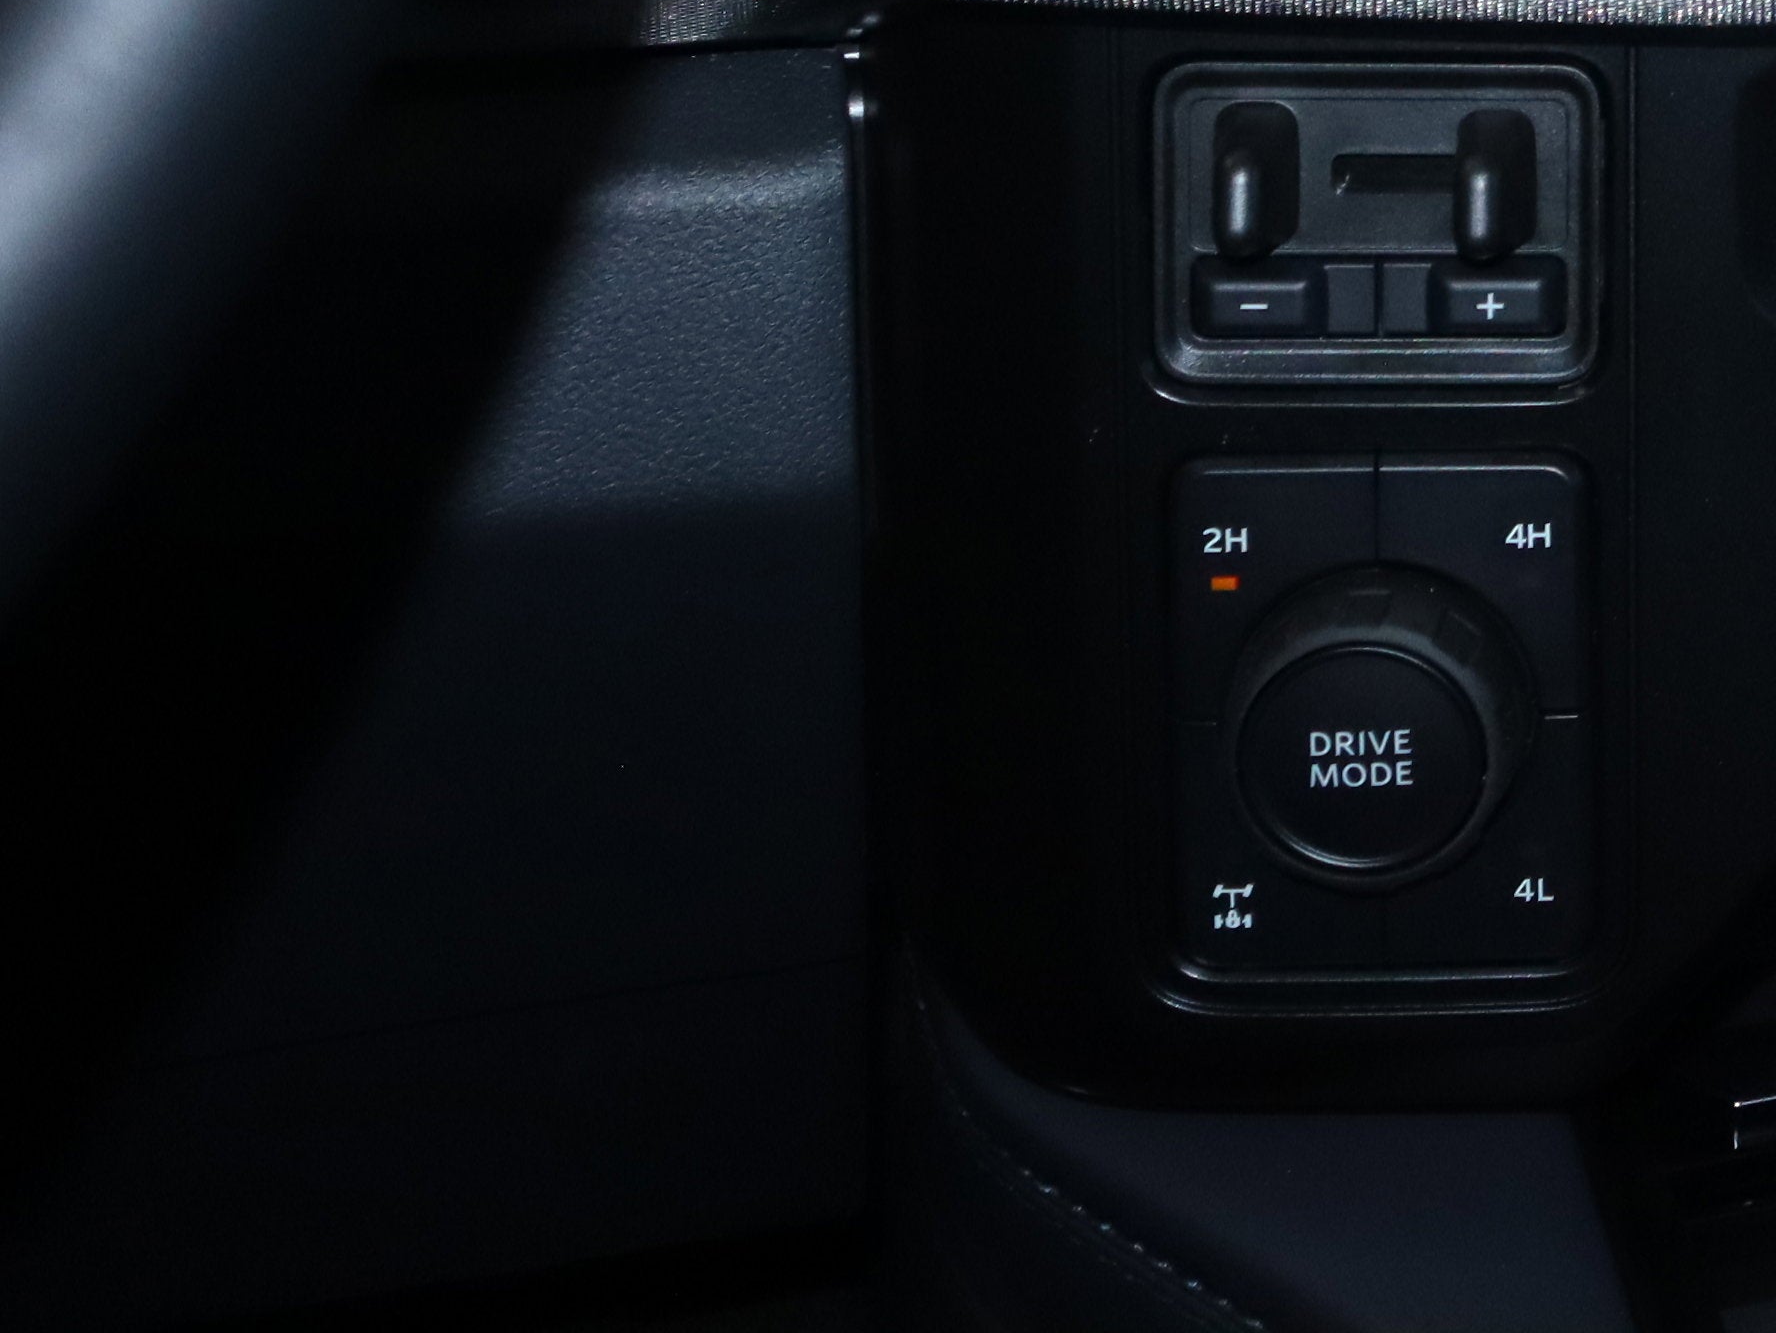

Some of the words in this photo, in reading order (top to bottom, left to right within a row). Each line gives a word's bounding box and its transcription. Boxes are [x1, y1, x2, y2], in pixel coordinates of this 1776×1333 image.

[1202, 528, 1249, 554] 2H
[1505, 523, 1552, 550] 4H
[1309, 729, 1412, 757] DRIVE
[1309, 761, 1414, 788] MODE
[1514, 878, 1554, 903] 4L
